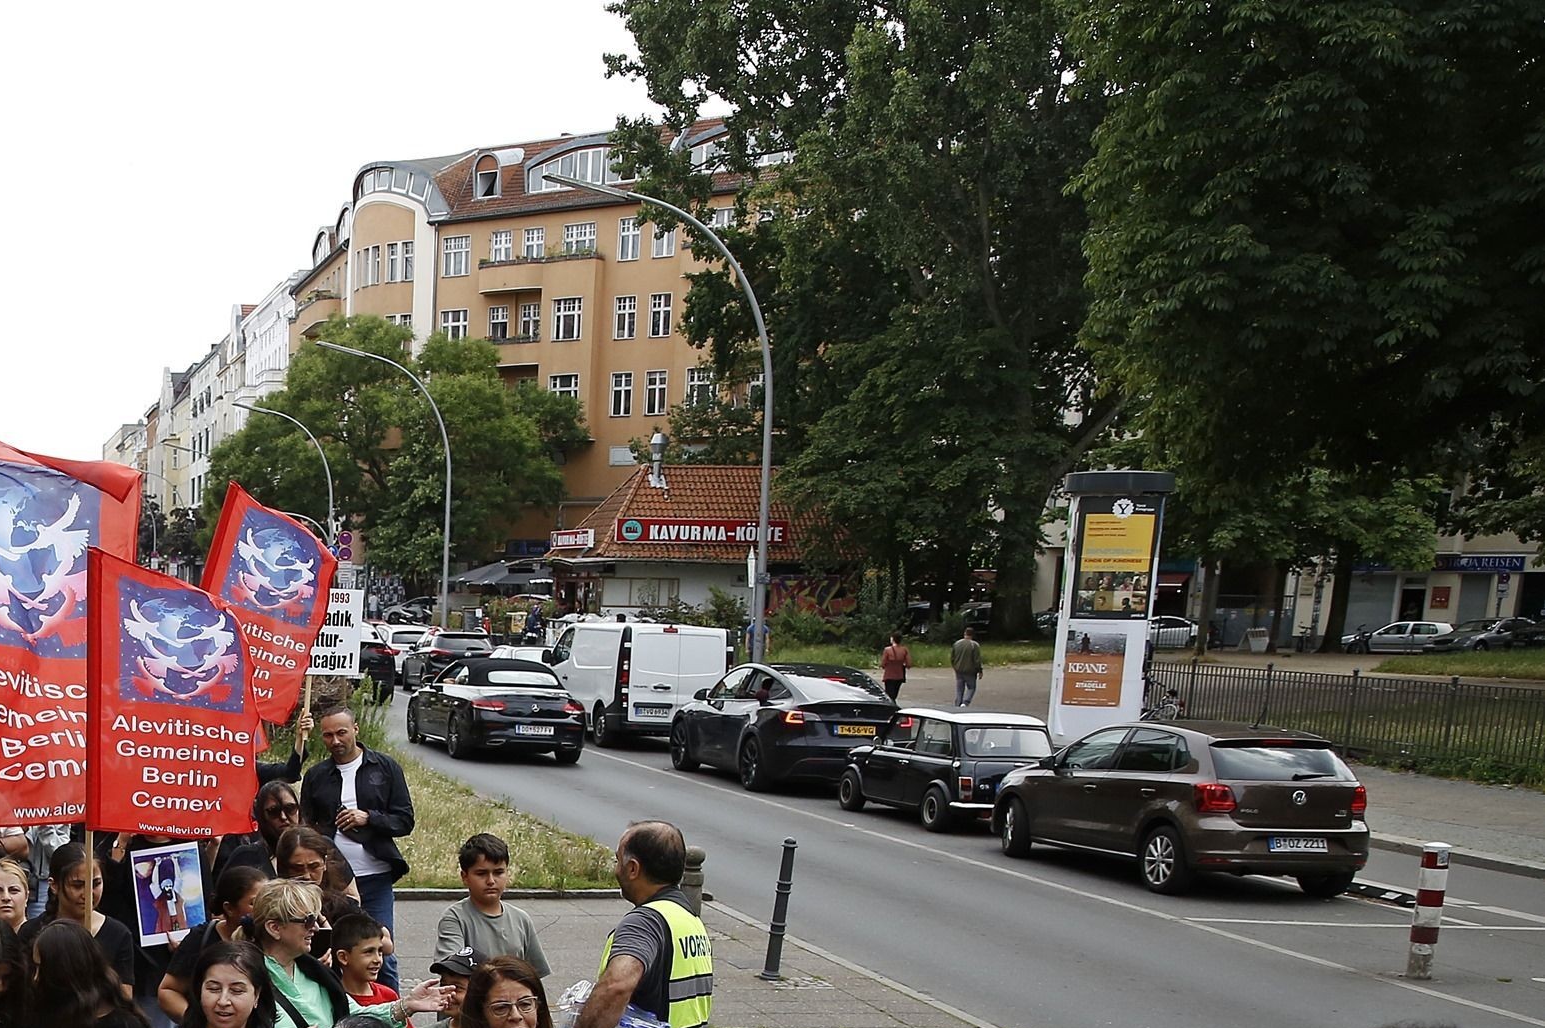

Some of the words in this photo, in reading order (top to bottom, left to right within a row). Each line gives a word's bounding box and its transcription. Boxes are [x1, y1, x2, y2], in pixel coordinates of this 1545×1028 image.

[649, 522, 783, 542] KAVURMA-KÖTE
[1481, 557, 1522, 568] REISEN
[331, 592, 351, 604] 1993
[1068, 662, 1108, 674] KEANE
[111, 715, 250, 744] Alevitische
[116, 740, 245, 767] Gemeinde
[142, 766, 218, 788] Berlin
[131, 791, 222, 812] Cemevi
[138, 822, 212, 836] www.alevi.org
[1275, 839, 1282, 849] B
[1303, 839, 1327, 849] 2211
